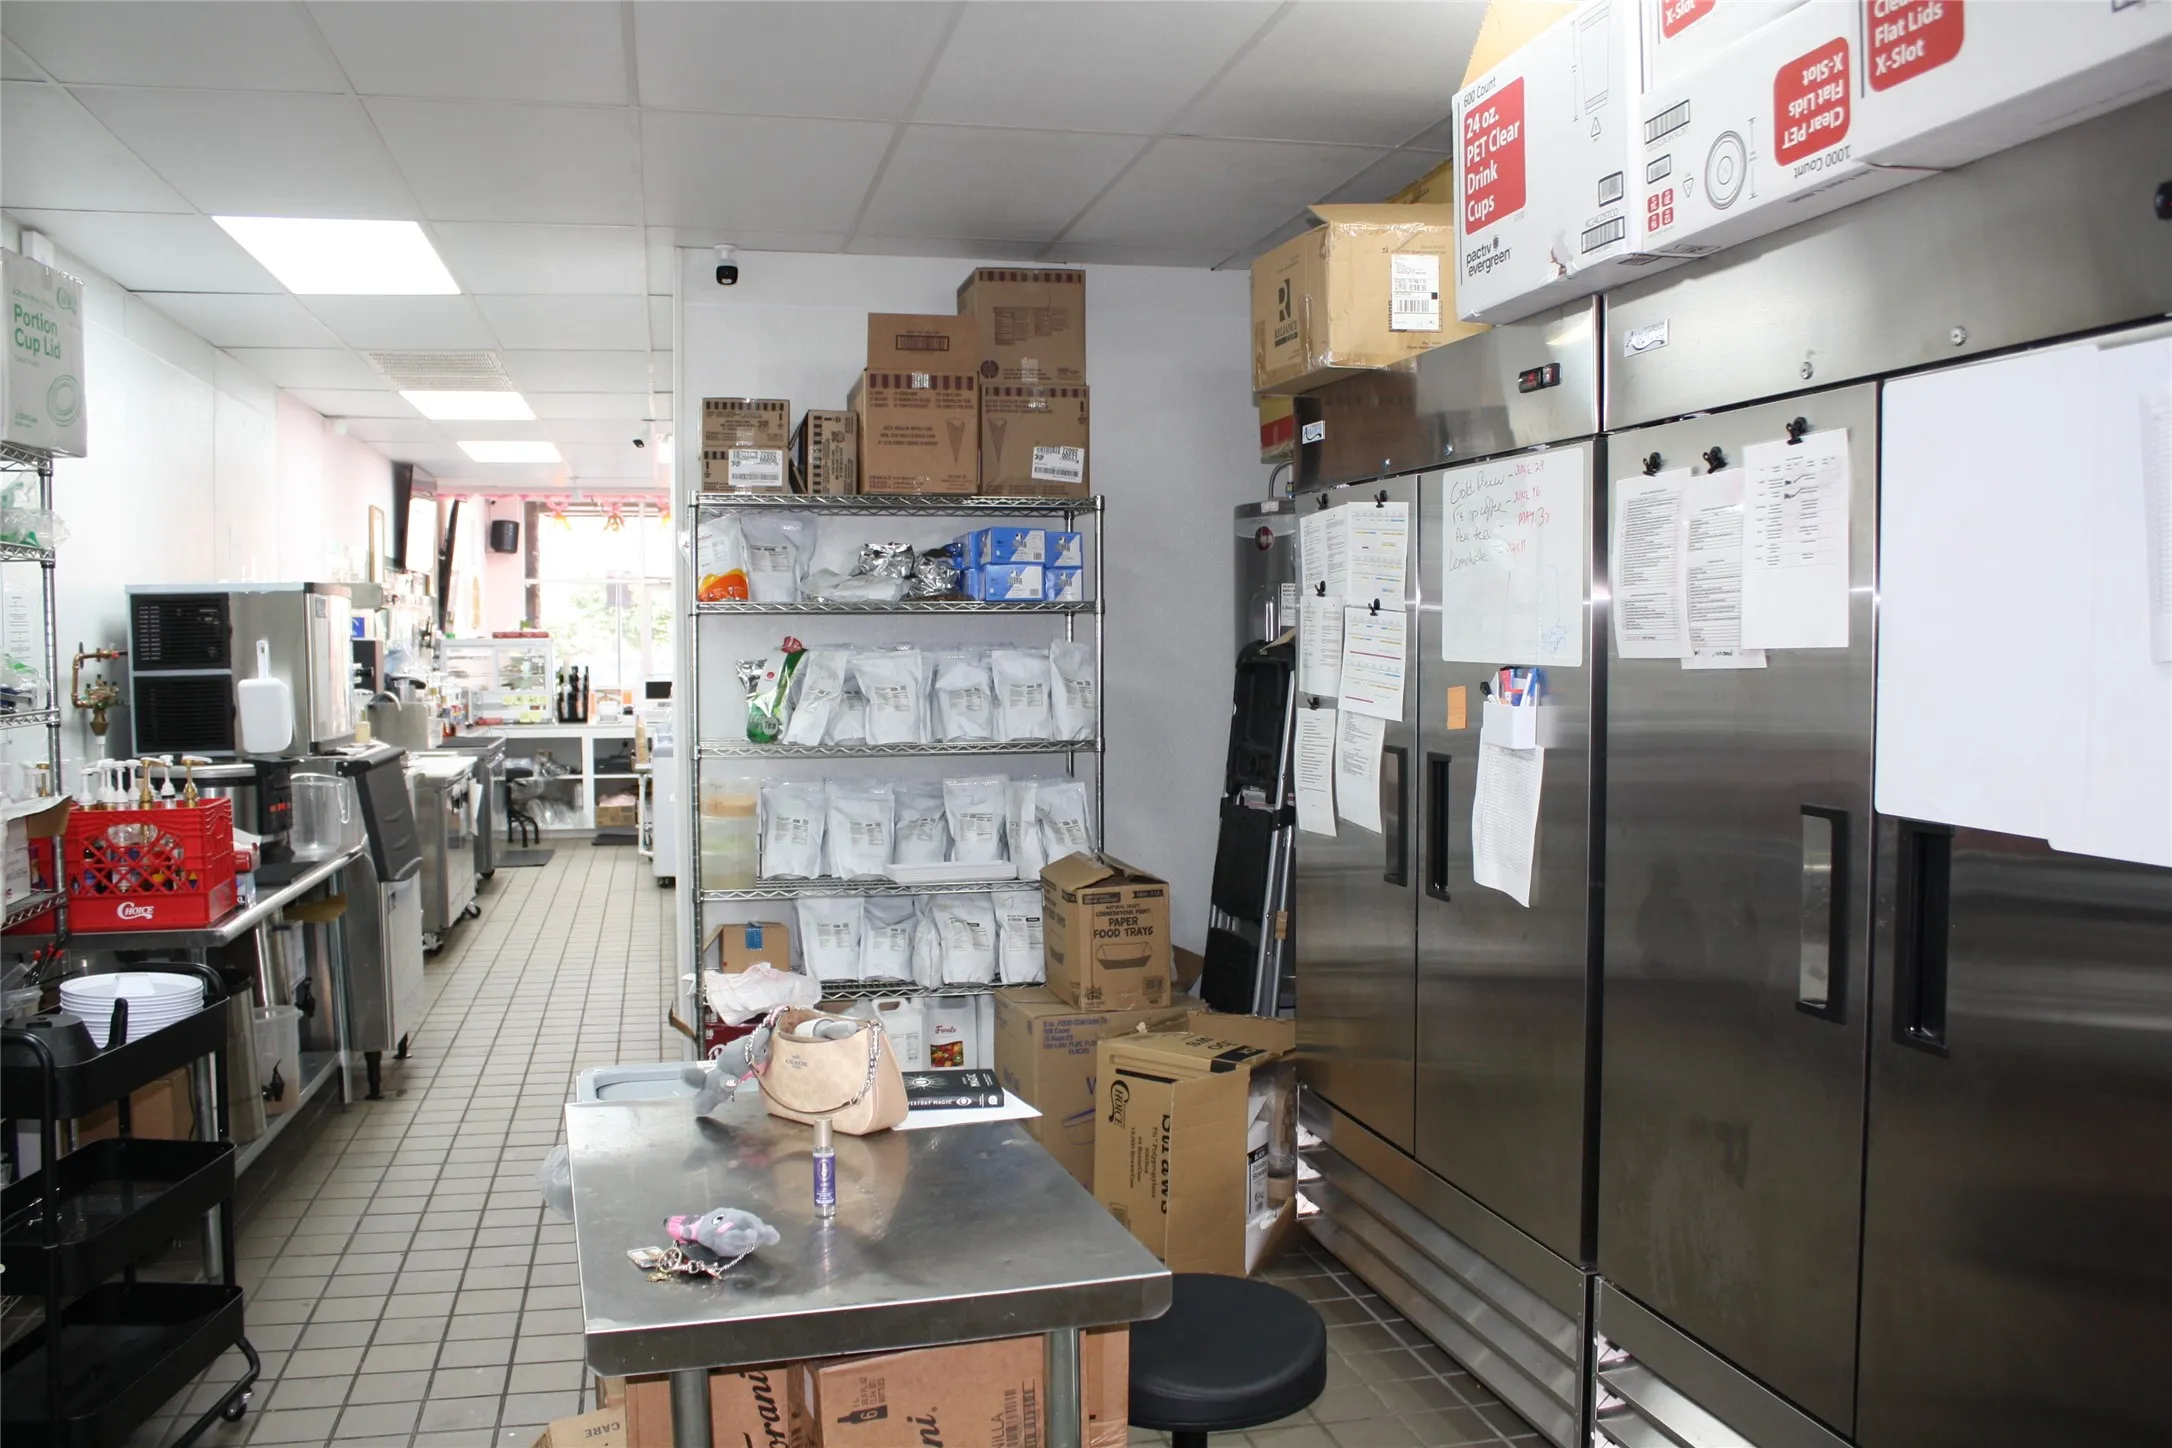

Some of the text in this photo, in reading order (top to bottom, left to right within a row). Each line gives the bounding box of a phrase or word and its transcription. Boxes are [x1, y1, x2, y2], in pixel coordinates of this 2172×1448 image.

[1875, 2, 1943, 47] Flat Lids
[1802, 51, 1844, 87] X-Slot
[1875, 39, 1925, 77] X-Slot
[1463, 76, 1497, 108] 600 Count
[1788, 79, 1844, 119] Flat Lids
[1466, 106, 1500, 139] 24 oz.
[1781, 106, 1845, 150] Clear PET
[1466, 120, 1521, 168] PET Clear
[1467, 160, 1498, 195] Drink
[1793, 144, 1852, 180] 1000 Count
[1467, 194, 1495, 222] Cups
[1466, 241, 1493, 268] pactiv
[1468, 249, 1511, 277] evergreen
[13, 303, 58, 337] Portion
[14, 327, 62, 360] Cup Lid
[117, 901, 155, 920] CHOICE
[1108, 916, 1139, 928] PAPER
[1093, 925, 1154, 939] FOOD TRAYS
[933, 1098, 953, 1106] MAGIC
[584, 1421, 621, 1439] CARE
[860, 1410, 878, 1421] 6
